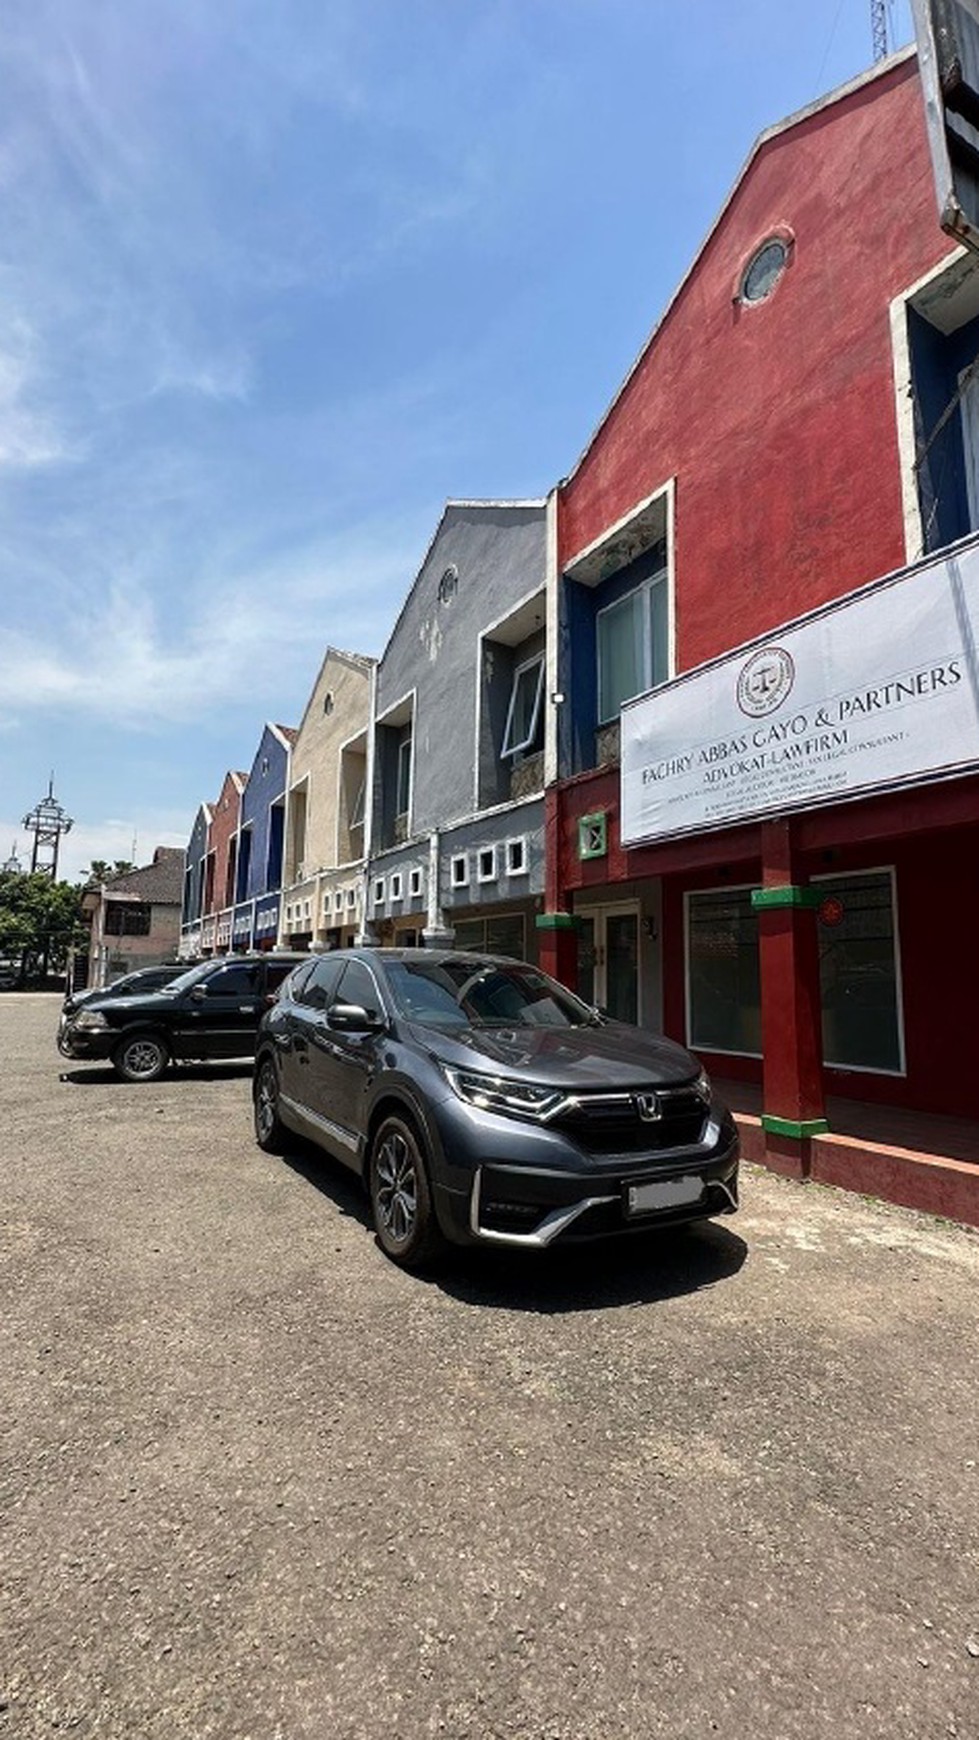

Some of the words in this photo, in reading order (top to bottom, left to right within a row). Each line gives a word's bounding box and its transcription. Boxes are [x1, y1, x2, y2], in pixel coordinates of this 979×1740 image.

[642, 754, 694, 785] FACHRY
[697, 735, 748, 764] ABBAS
[752, 715, 808, 748] GAYO
[815, 707, 835, 727] &
[839, 661, 962, 721] PARTNERS
